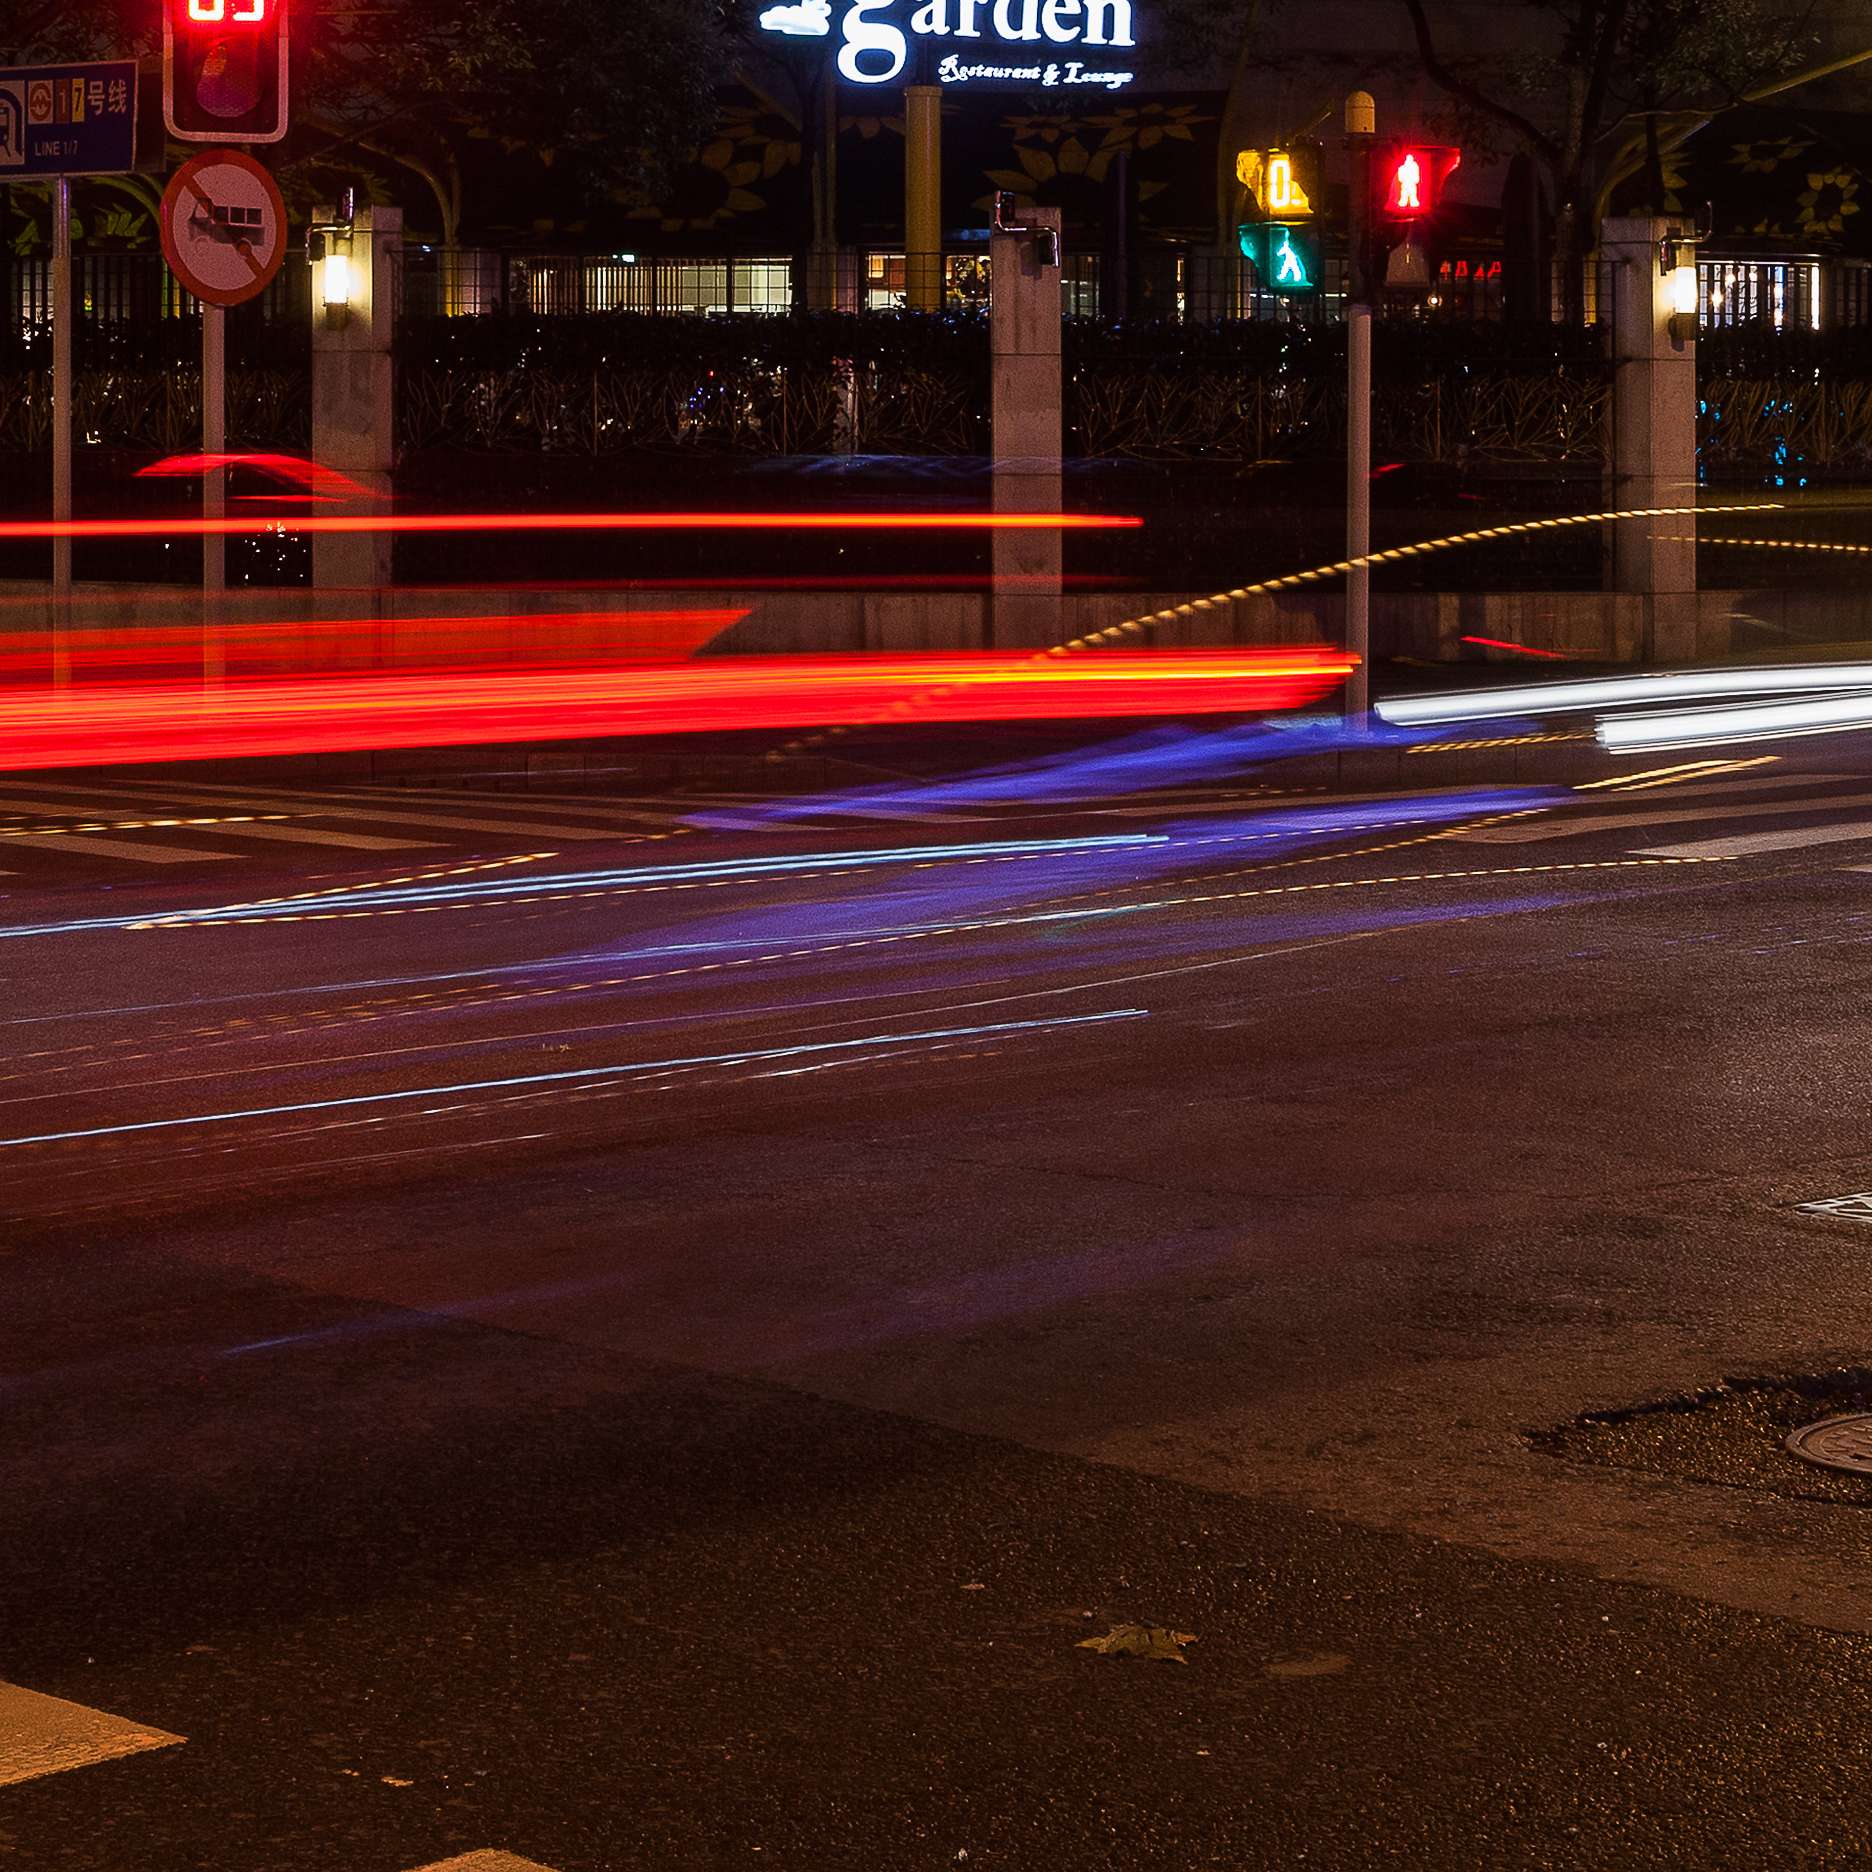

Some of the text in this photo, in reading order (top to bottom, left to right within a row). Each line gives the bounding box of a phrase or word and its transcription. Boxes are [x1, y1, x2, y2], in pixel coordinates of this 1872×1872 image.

[938, 54, 1134, 90] Restaurant & Lounge
[34, 141, 62, 158] LINE
